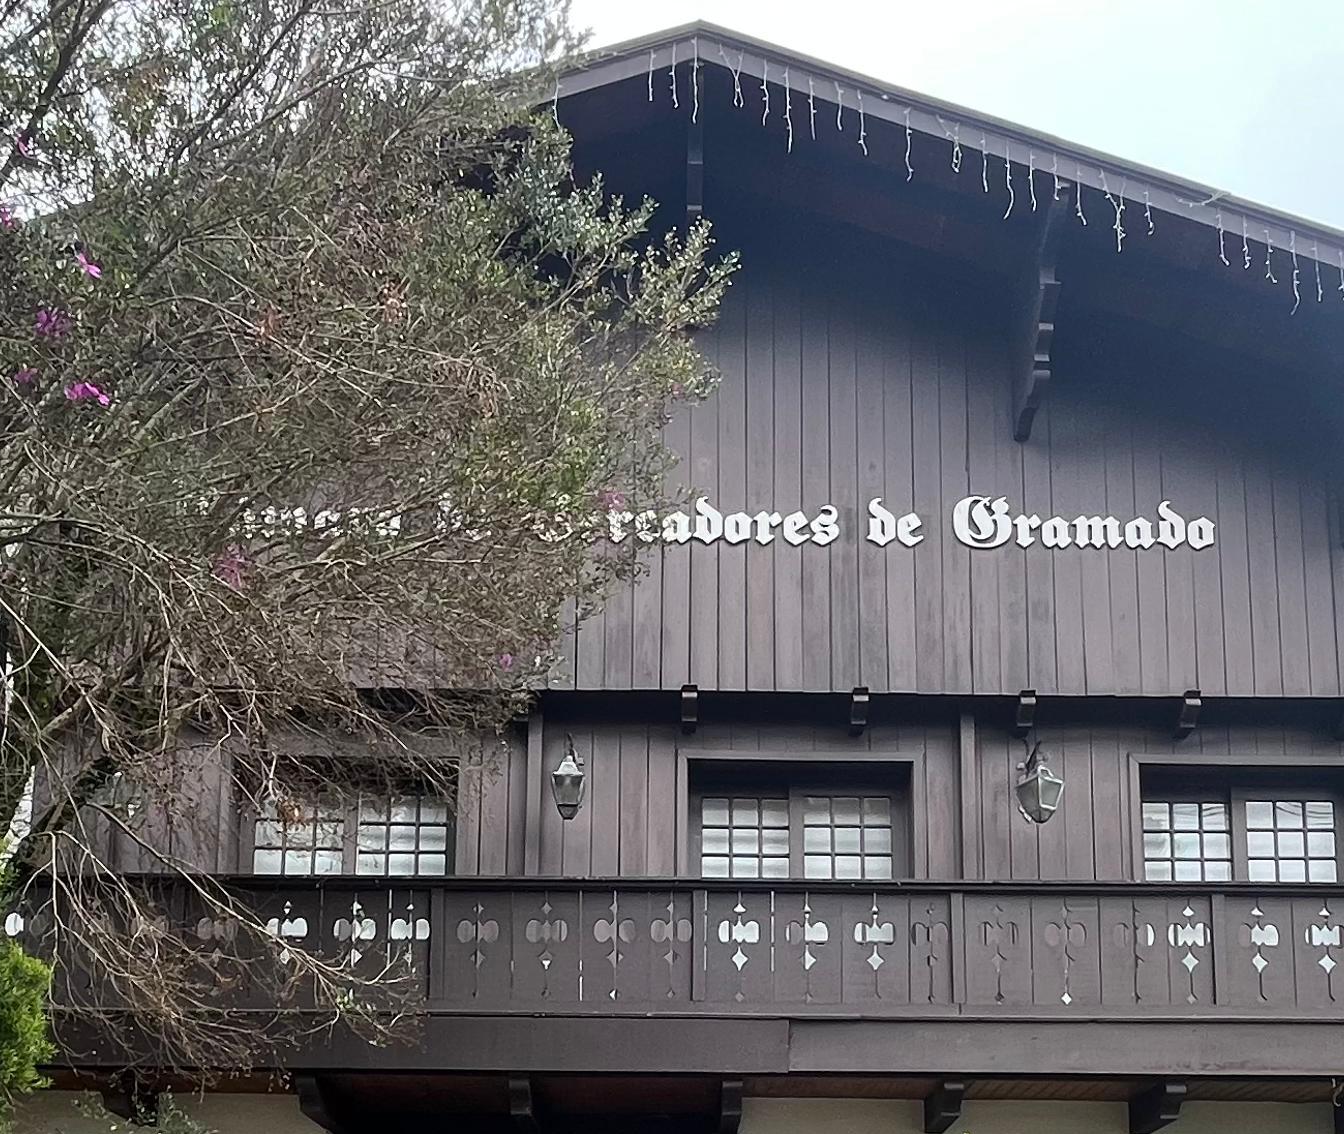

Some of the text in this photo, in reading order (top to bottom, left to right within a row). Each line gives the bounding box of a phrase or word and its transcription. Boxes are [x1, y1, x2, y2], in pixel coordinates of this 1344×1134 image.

[532, 494, 841, 546] readores
[866, 497, 924, 547] de
[952, 495, 1217, 550] Gramado
